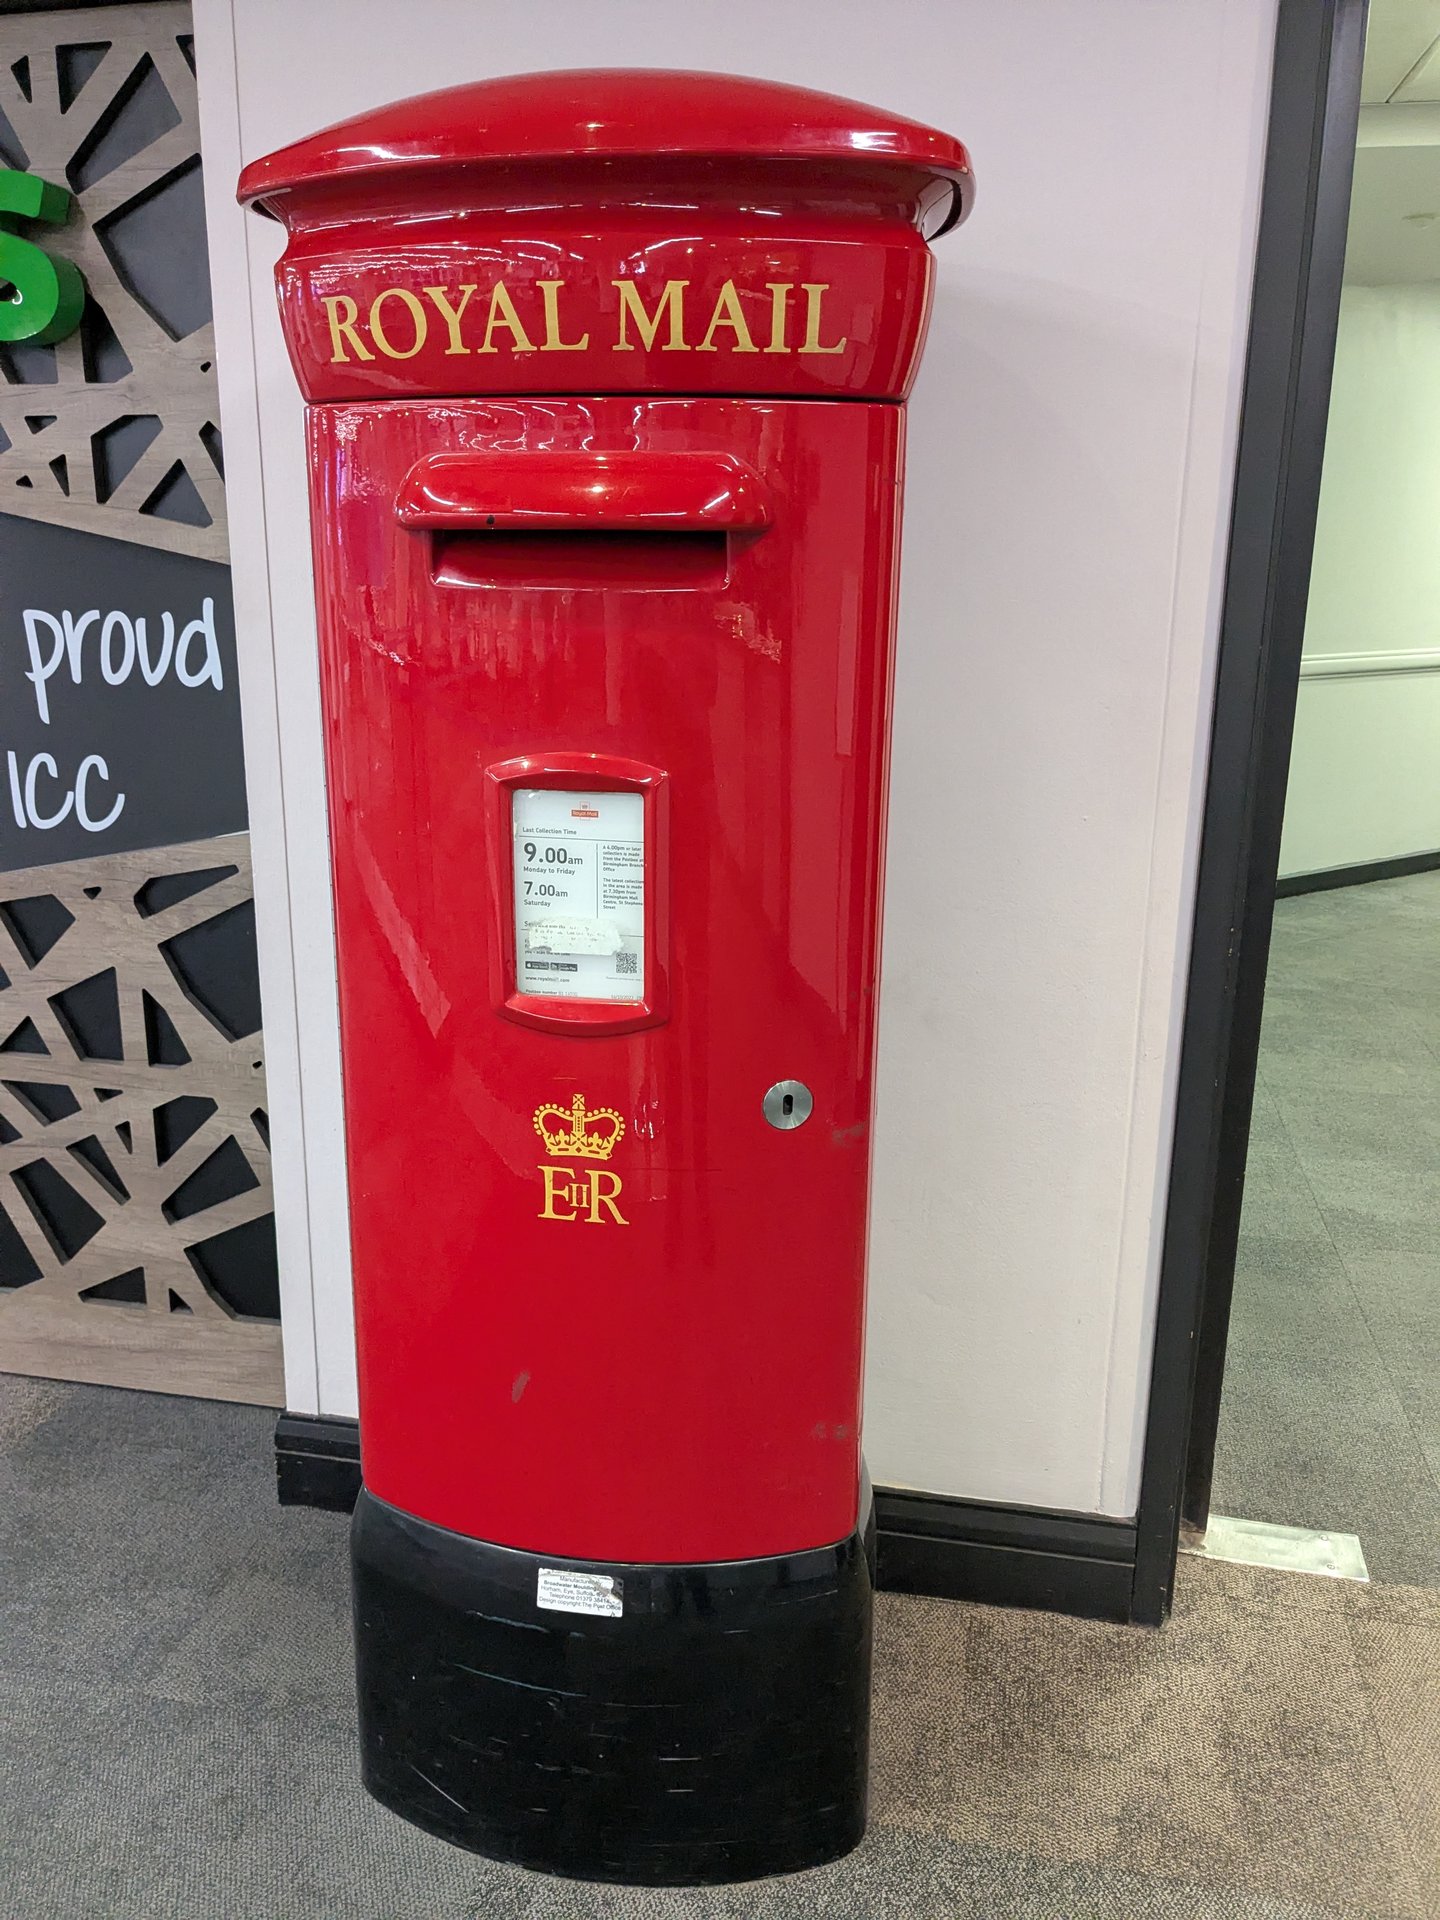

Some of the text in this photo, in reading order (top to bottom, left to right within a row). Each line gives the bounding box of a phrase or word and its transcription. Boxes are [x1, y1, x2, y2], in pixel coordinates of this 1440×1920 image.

[321, 279, 847, 363] ROYAL MAIL
[23, 597, 223, 724] proud
[7, 750, 125, 832] ICC
[524, 842, 583, 864] 9.00am
[524, 866, 547, 874] Monday
[524, 881, 568, 898] 7.00am
[544, 1580, 572, 1588] Broadwater
[550, 1592, 575, 1600] Telephone
